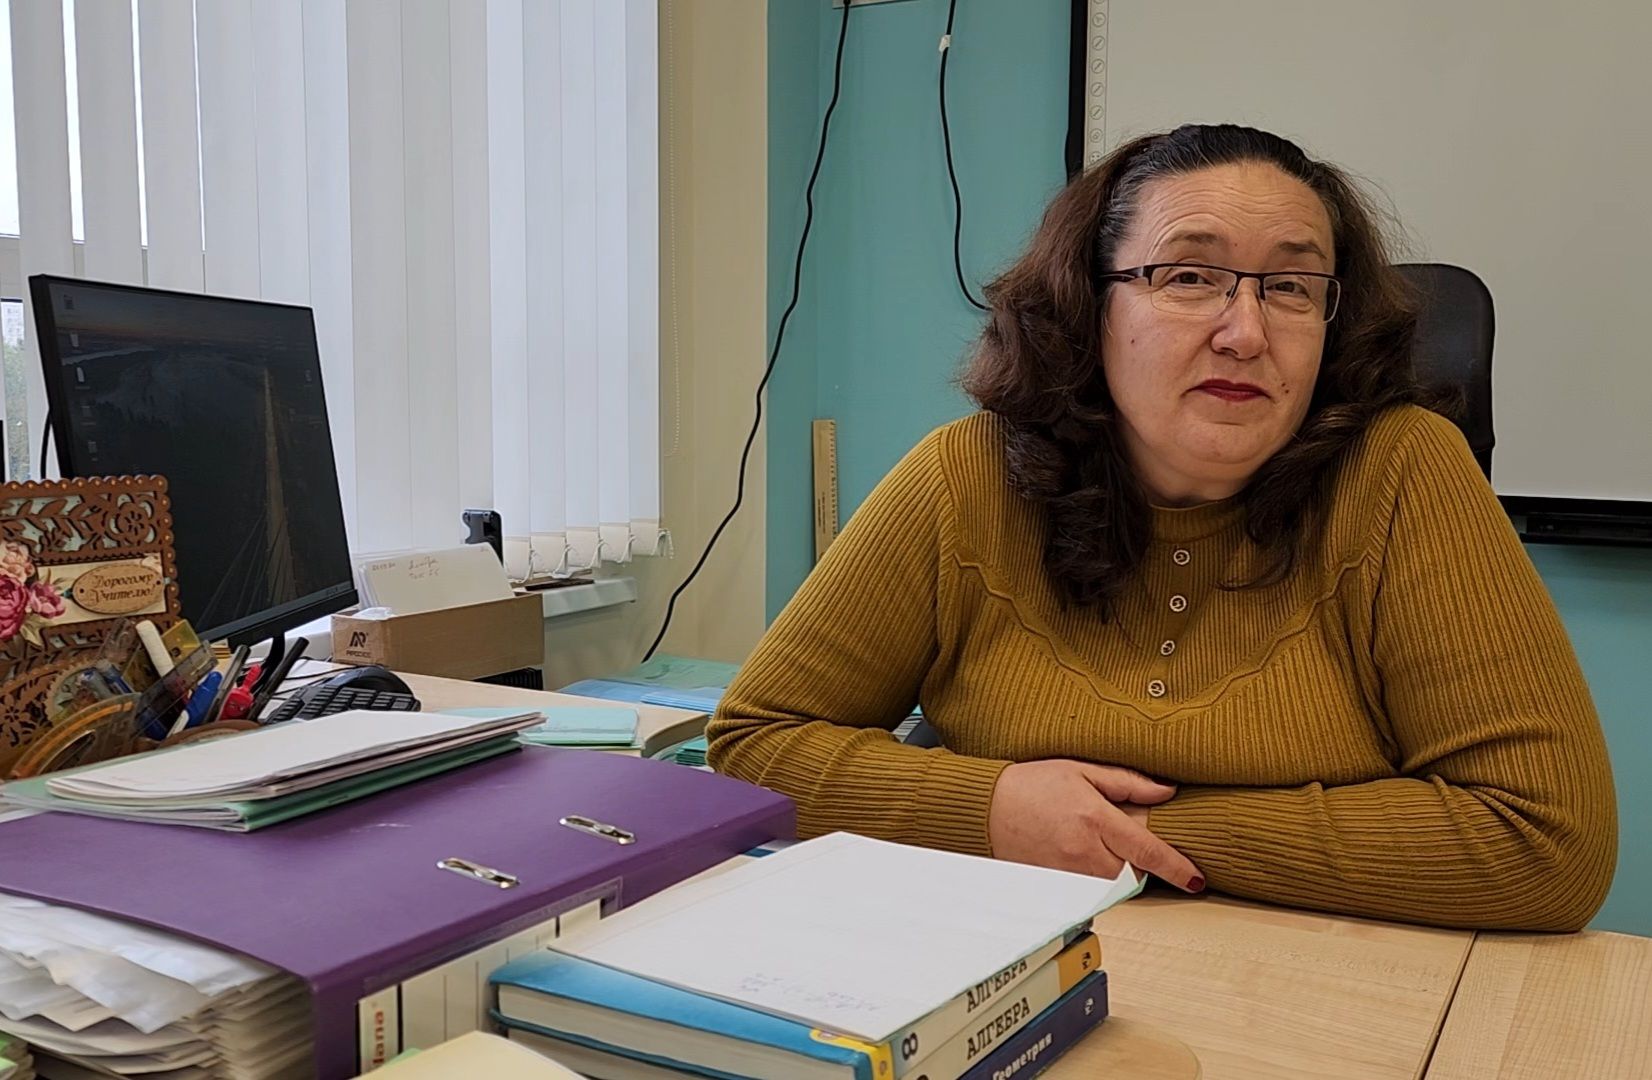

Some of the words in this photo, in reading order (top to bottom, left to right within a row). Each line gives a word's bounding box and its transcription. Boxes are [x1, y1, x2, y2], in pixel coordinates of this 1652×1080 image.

[901, 1032, 919, 1061] 8
[966, 997, 1031, 1061] АЛГЕБРА
[992, 1032, 1053, 1080] Геометрия
